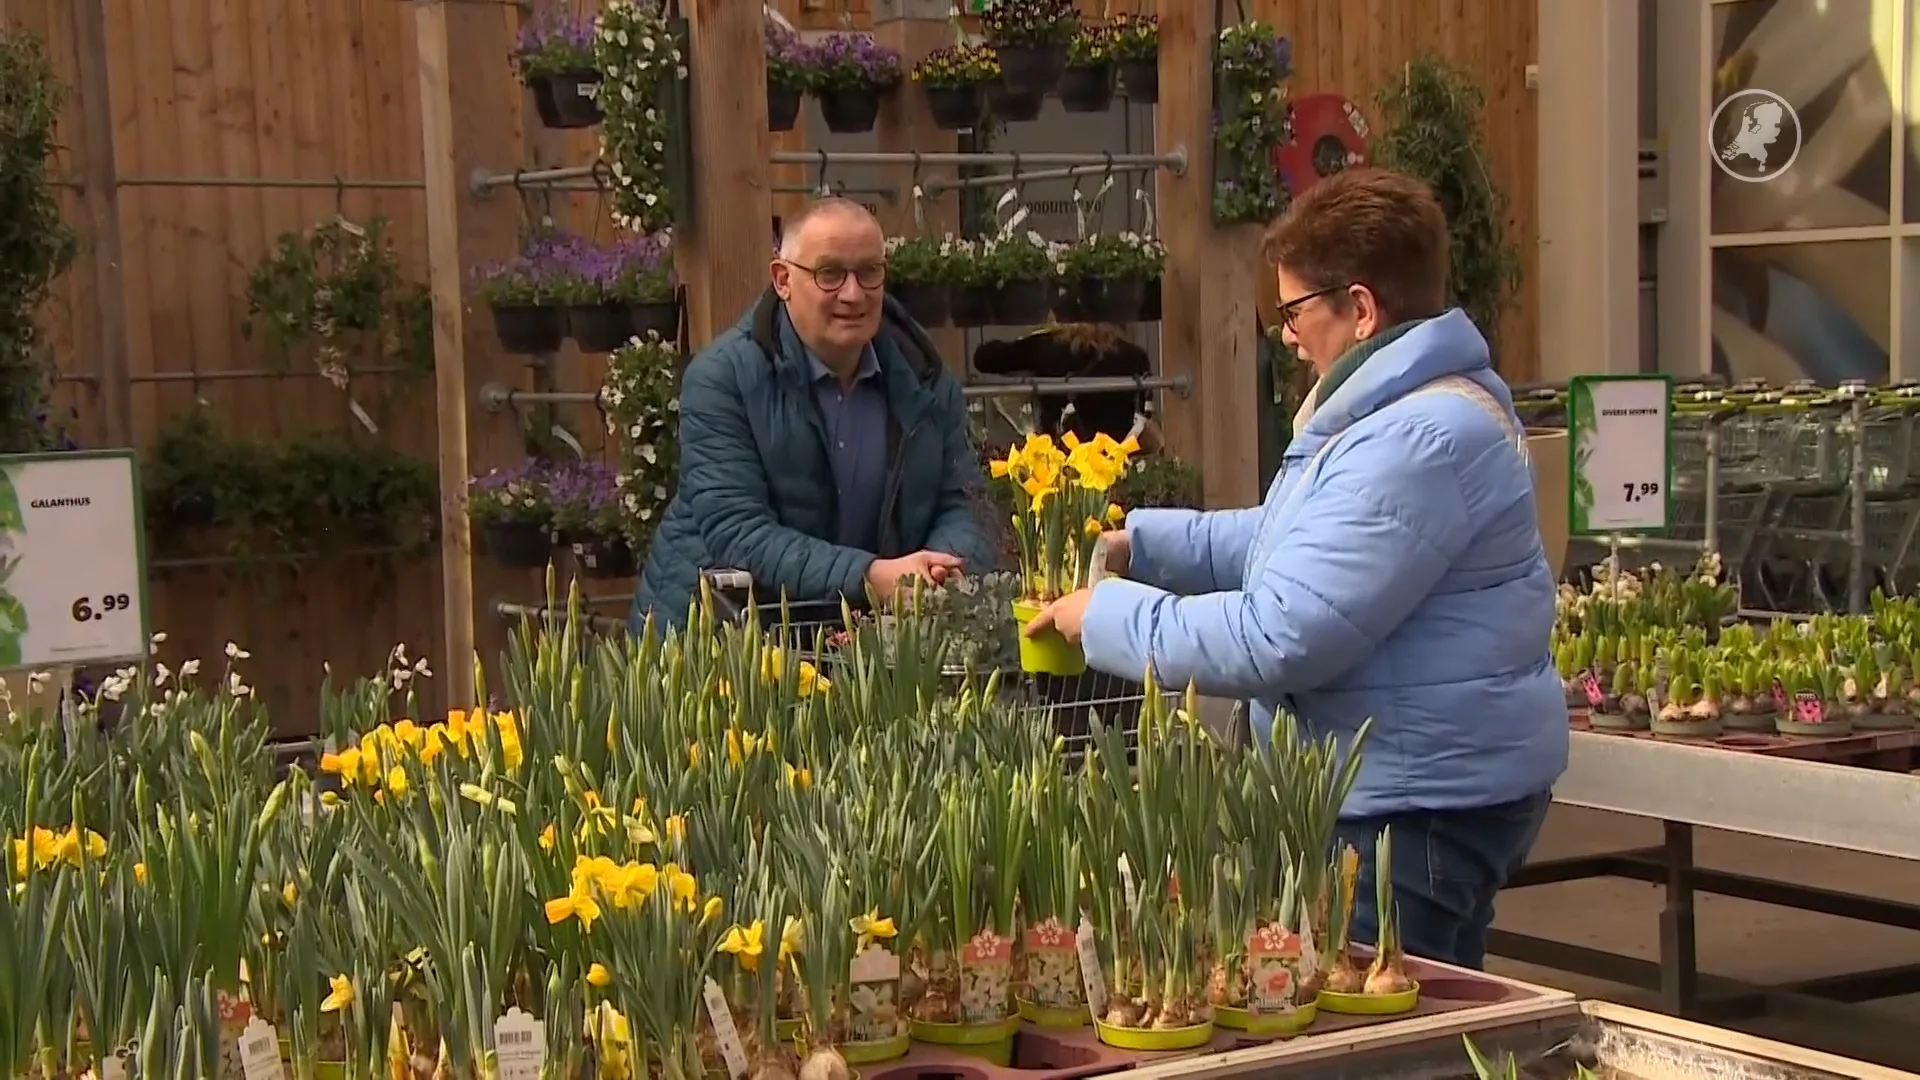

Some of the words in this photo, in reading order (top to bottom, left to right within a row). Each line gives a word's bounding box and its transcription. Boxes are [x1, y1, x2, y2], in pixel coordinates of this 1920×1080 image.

[1623, 483, 1659, 502] 7.99
[30, 496, 91, 509] GALANTHUS
[71, 593, 130, 623] 6.99
